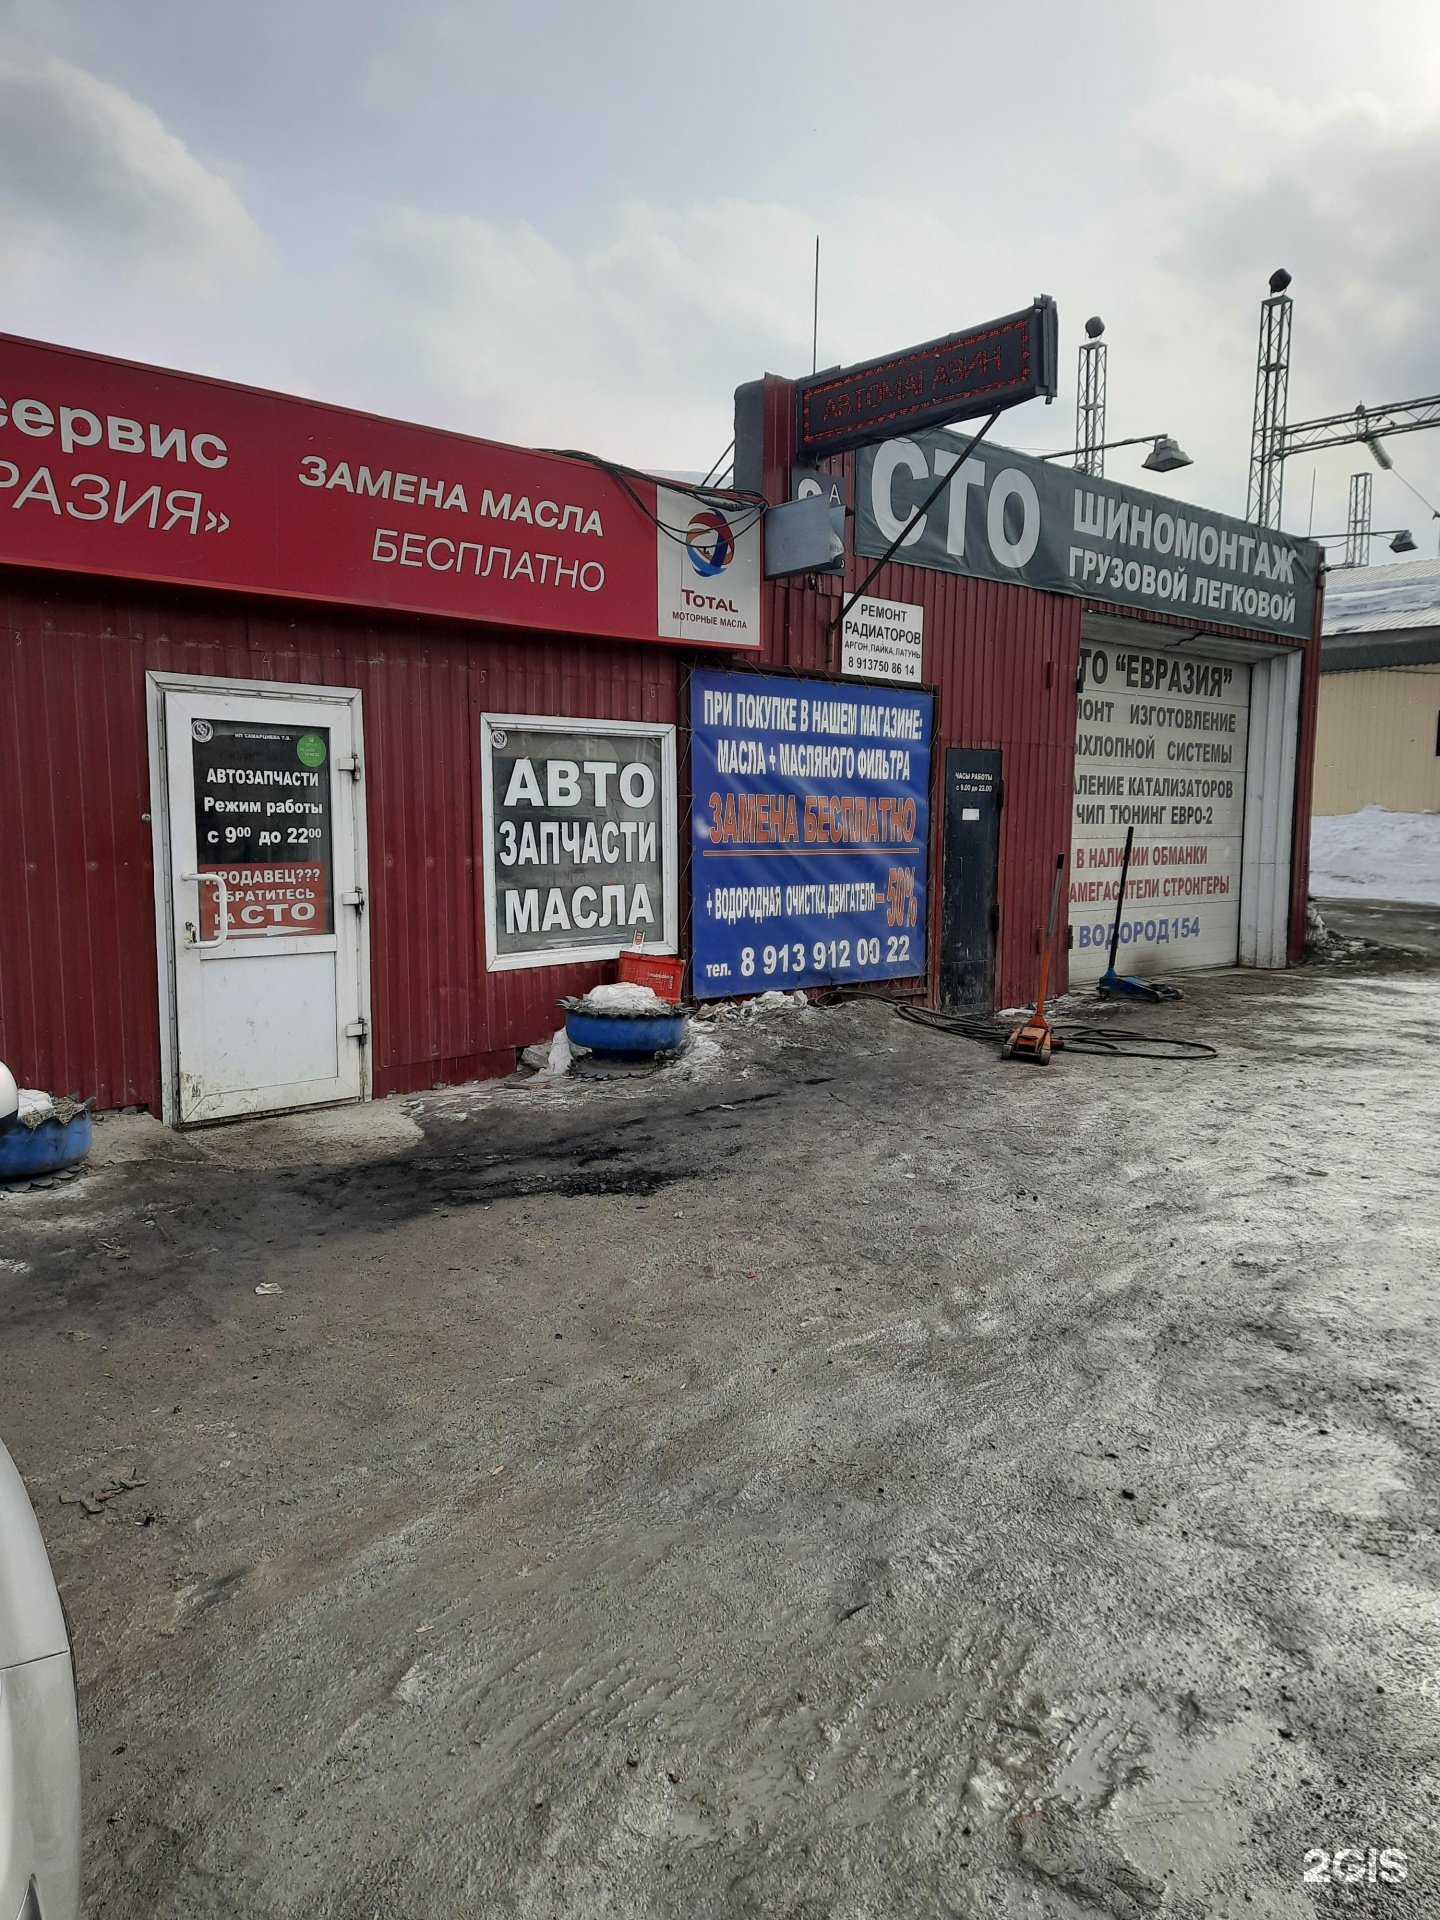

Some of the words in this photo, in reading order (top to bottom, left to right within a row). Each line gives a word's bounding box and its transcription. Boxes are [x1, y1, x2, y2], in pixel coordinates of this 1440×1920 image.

[0, 397, 229, 469] ервис
[298, 455, 469, 513] ЗАМЕНА
[480, 489, 604, 537] МАСЛА
[871, 437, 1041, 569] СТО
[1073, 488, 1297, 584] ШИНОМОНТАЖ
[371, 528, 606, 593] БЕСПЛАТНО
[1069, 546, 1188, 602] ГРУЗОВОЙ
[1192, 576, 1296, 624] ЛЕГКОВОЙ
[672, 611, 718, 625] МОТОРНЫЕ
[719, 618, 748, 629] МАСЛА
[861, 603, 908, 623] РЕМОНТ
[844, 620, 921, 645] РАДИАТОРОВ
[848, 656, 854, 668] 8
[856, 657, 889, 673] 913750
[891, 662, 902, 674] 86
[905, 664, 915, 676] 14
[704, 690, 732, 726] ПРИ
[736, 693, 797, 731] ПОКУПКЕ
[800, 699, 809, 732] В
[812, 700, 858, 736] НАШЕМ
[861, 704, 923, 741] МАГАЗИНЕ:
[1130, 703, 1236, 733] ИЗГОТОВЛЕНИЕ
[717, 739, 766, 775] МАСЛА
[769, 746, 776, 772] +
[779, 743, 854, 779] МАСЛЯНОГО
[857, 748, 910, 781] ФИЛЬТРА
[1167, 740, 1233, 764] СИСТЕМЫ
[206, 767, 320, 787] АВТОЗАПЧАСТИ
[502, 758, 655, 809] АВТО
[1128, 776, 1234, 799] КАТАЛИЗАТОРОВ
[203, 796, 262, 813] Режим
[266, 798, 323, 817] работы
[708, 791, 799, 844] ЗАМЕНА
[804, 795, 917, 844] БЕСПЛАТНО
[1076, 804, 1105, 825] ЧИП
[1110, 804, 1167, 825] ТЮНИНГ
[1171, 805, 1213, 825] ЕВРО-2
[207, 830, 220, 843] с
[259, 831, 282, 846] до
[499, 820, 656, 866] ЗАПЧАСТИ
[1076, 848, 1085, 868] В
[1089, 846, 1150, 868] НАЛИИИ
[1152, 846, 1208, 867] ОБМАНКИ
[715, 886, 782, 925] ВОДОРОДНАЯ
[786, 884, 826, 915] ОЧИСТКА
[827, 882, 876, 919] ДВИГАТЕЛЯ
[1163, 875, 1230, 897] СТРОНГЕРЫ
[241, 902, 316, 924] СТО
[504, 883, 656, 935] МАСЛА
[706, 962, 732, 977] тел.
[740, 947, 755, 977] 8
[763, 943, 806, 975] 913
[813, 939, 851, 970] 912
[856, 937, 880, 966] 00
[886, 935, 910, 963] 22
